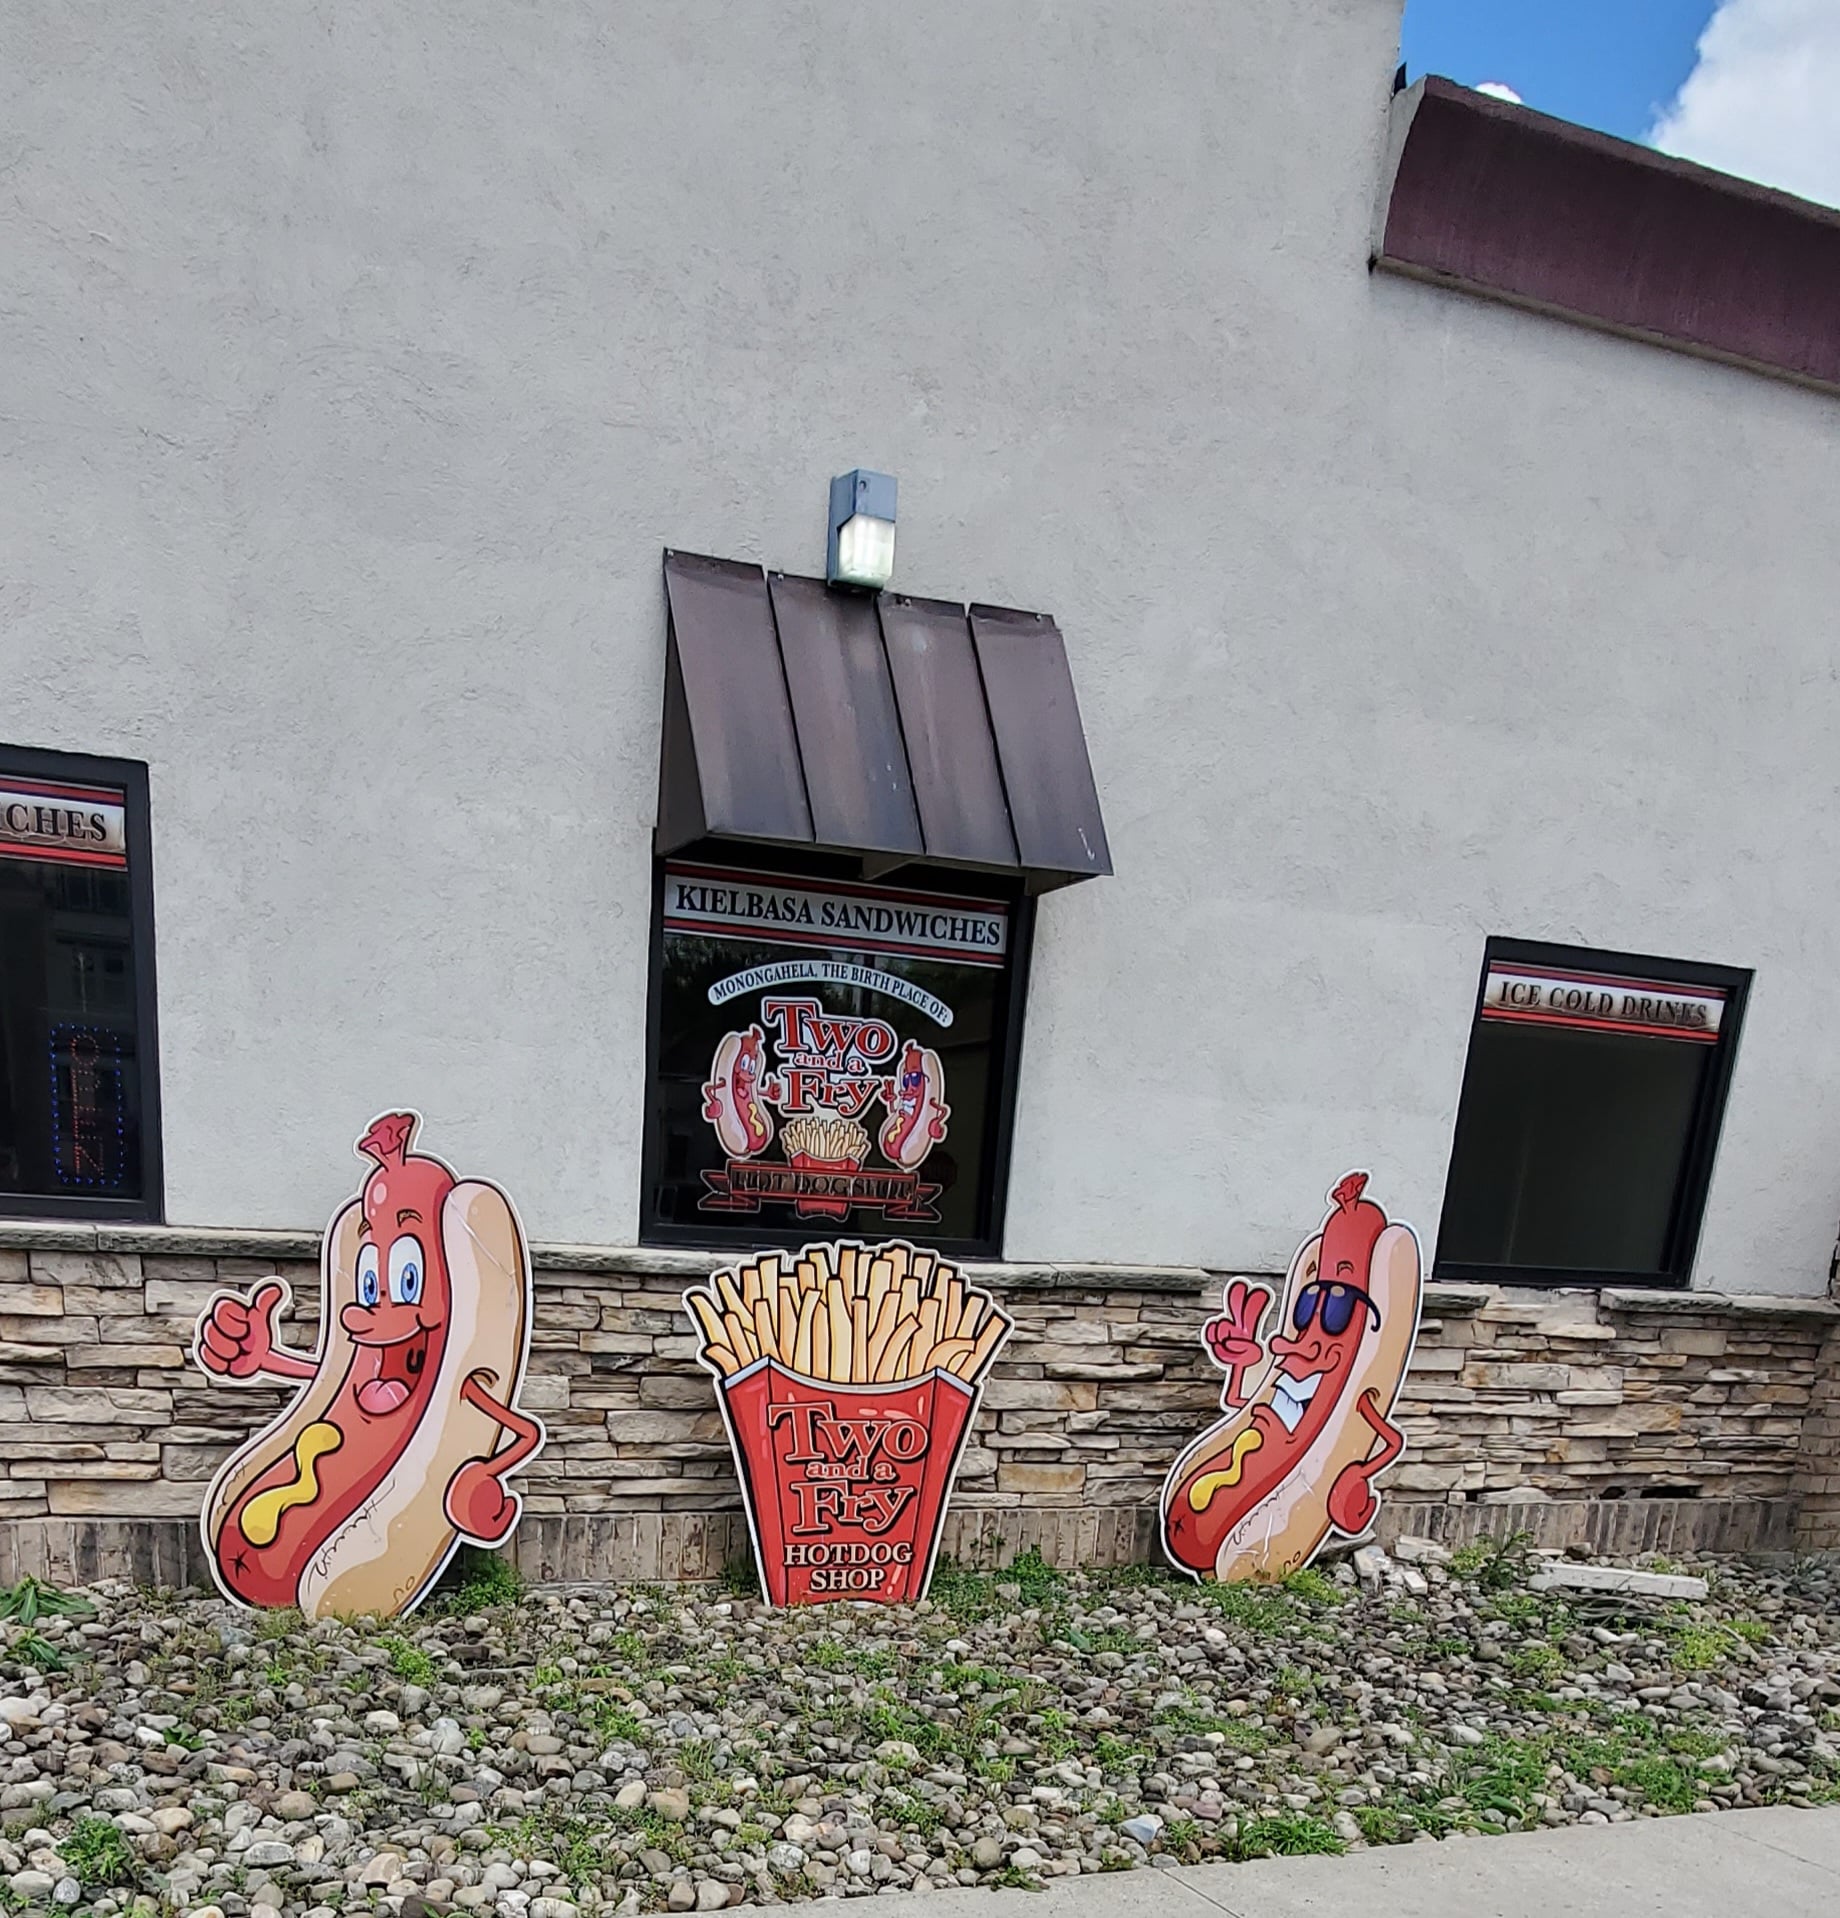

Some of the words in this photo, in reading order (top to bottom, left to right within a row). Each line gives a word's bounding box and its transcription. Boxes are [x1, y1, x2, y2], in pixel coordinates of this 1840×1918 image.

[0, 803, 107, 842] CHES
[676, 884, 814, 925] KIELBASA
[821, 901, 1001, 946] SANDWICHES
[713, 963, 818, 1001] MONONGAHELA,
[822, 963, 848, 980] THE
[851, 966, 890, 991] BIRTH
[891, 979, 930, 1009] PLACE
[1500, 981, 1541, 1006] ICE
[1549, 987, 1614, 1014] COLD
[1620, 994, 1708, 1026] DRINKS
[765, 1001, 893, 1058] Two
[794, 1051, 844, 1071] and
[847, 1057, 866, 1073] a
[781, 1068, 880, 1116] Fry
[795, 1173, 850, 1196] DOG
[768, 1401, 928, 1461] Two
[806, 1456, 869, 1481] and
[874, 1461, 896, 1482] a
[791, 1479, 914, 1534] Fry
[783, 1543, 913, 1567] HOTDOG
[810, 1567, 885, 1592] SHOP
